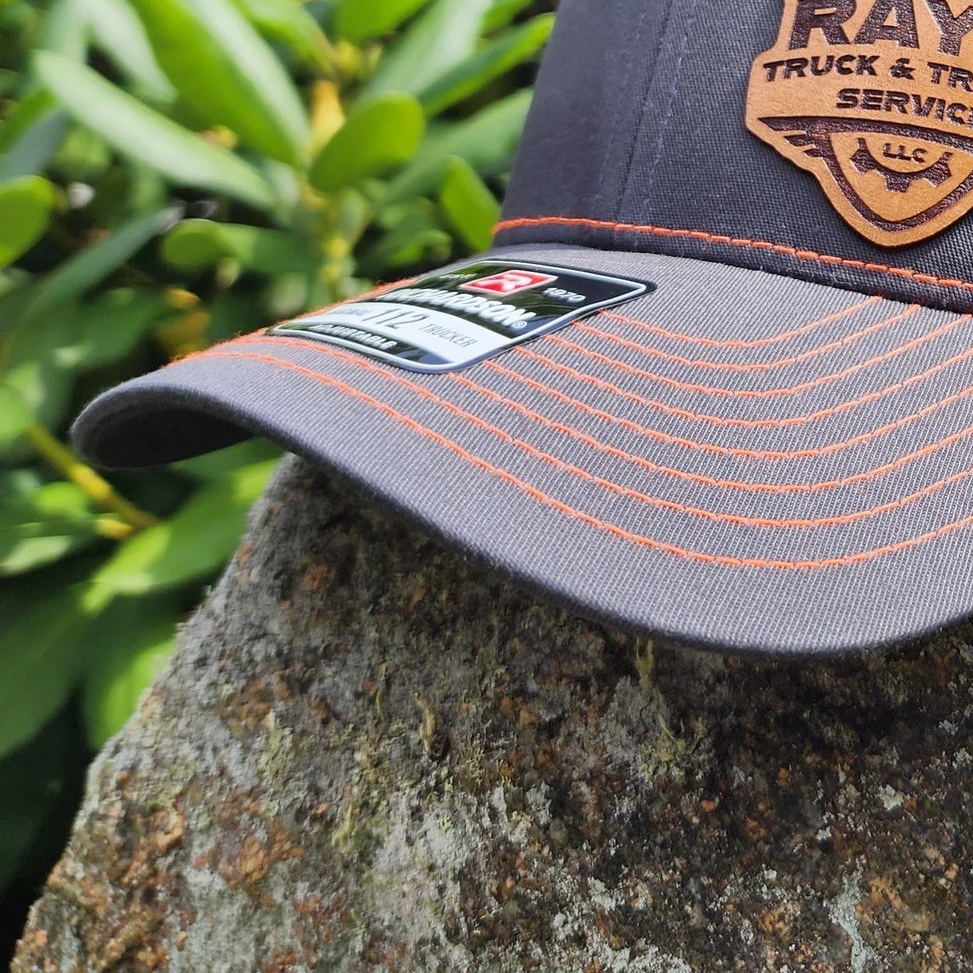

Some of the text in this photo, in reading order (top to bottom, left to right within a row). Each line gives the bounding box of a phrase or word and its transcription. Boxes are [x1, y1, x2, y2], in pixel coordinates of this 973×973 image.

[763, 54, 881, 82] TRUCK
[889, 57, 916, 80] &
[883, 142, 926, 163] LLC
[361, 308, 479, 349] 112 TRUCKER
